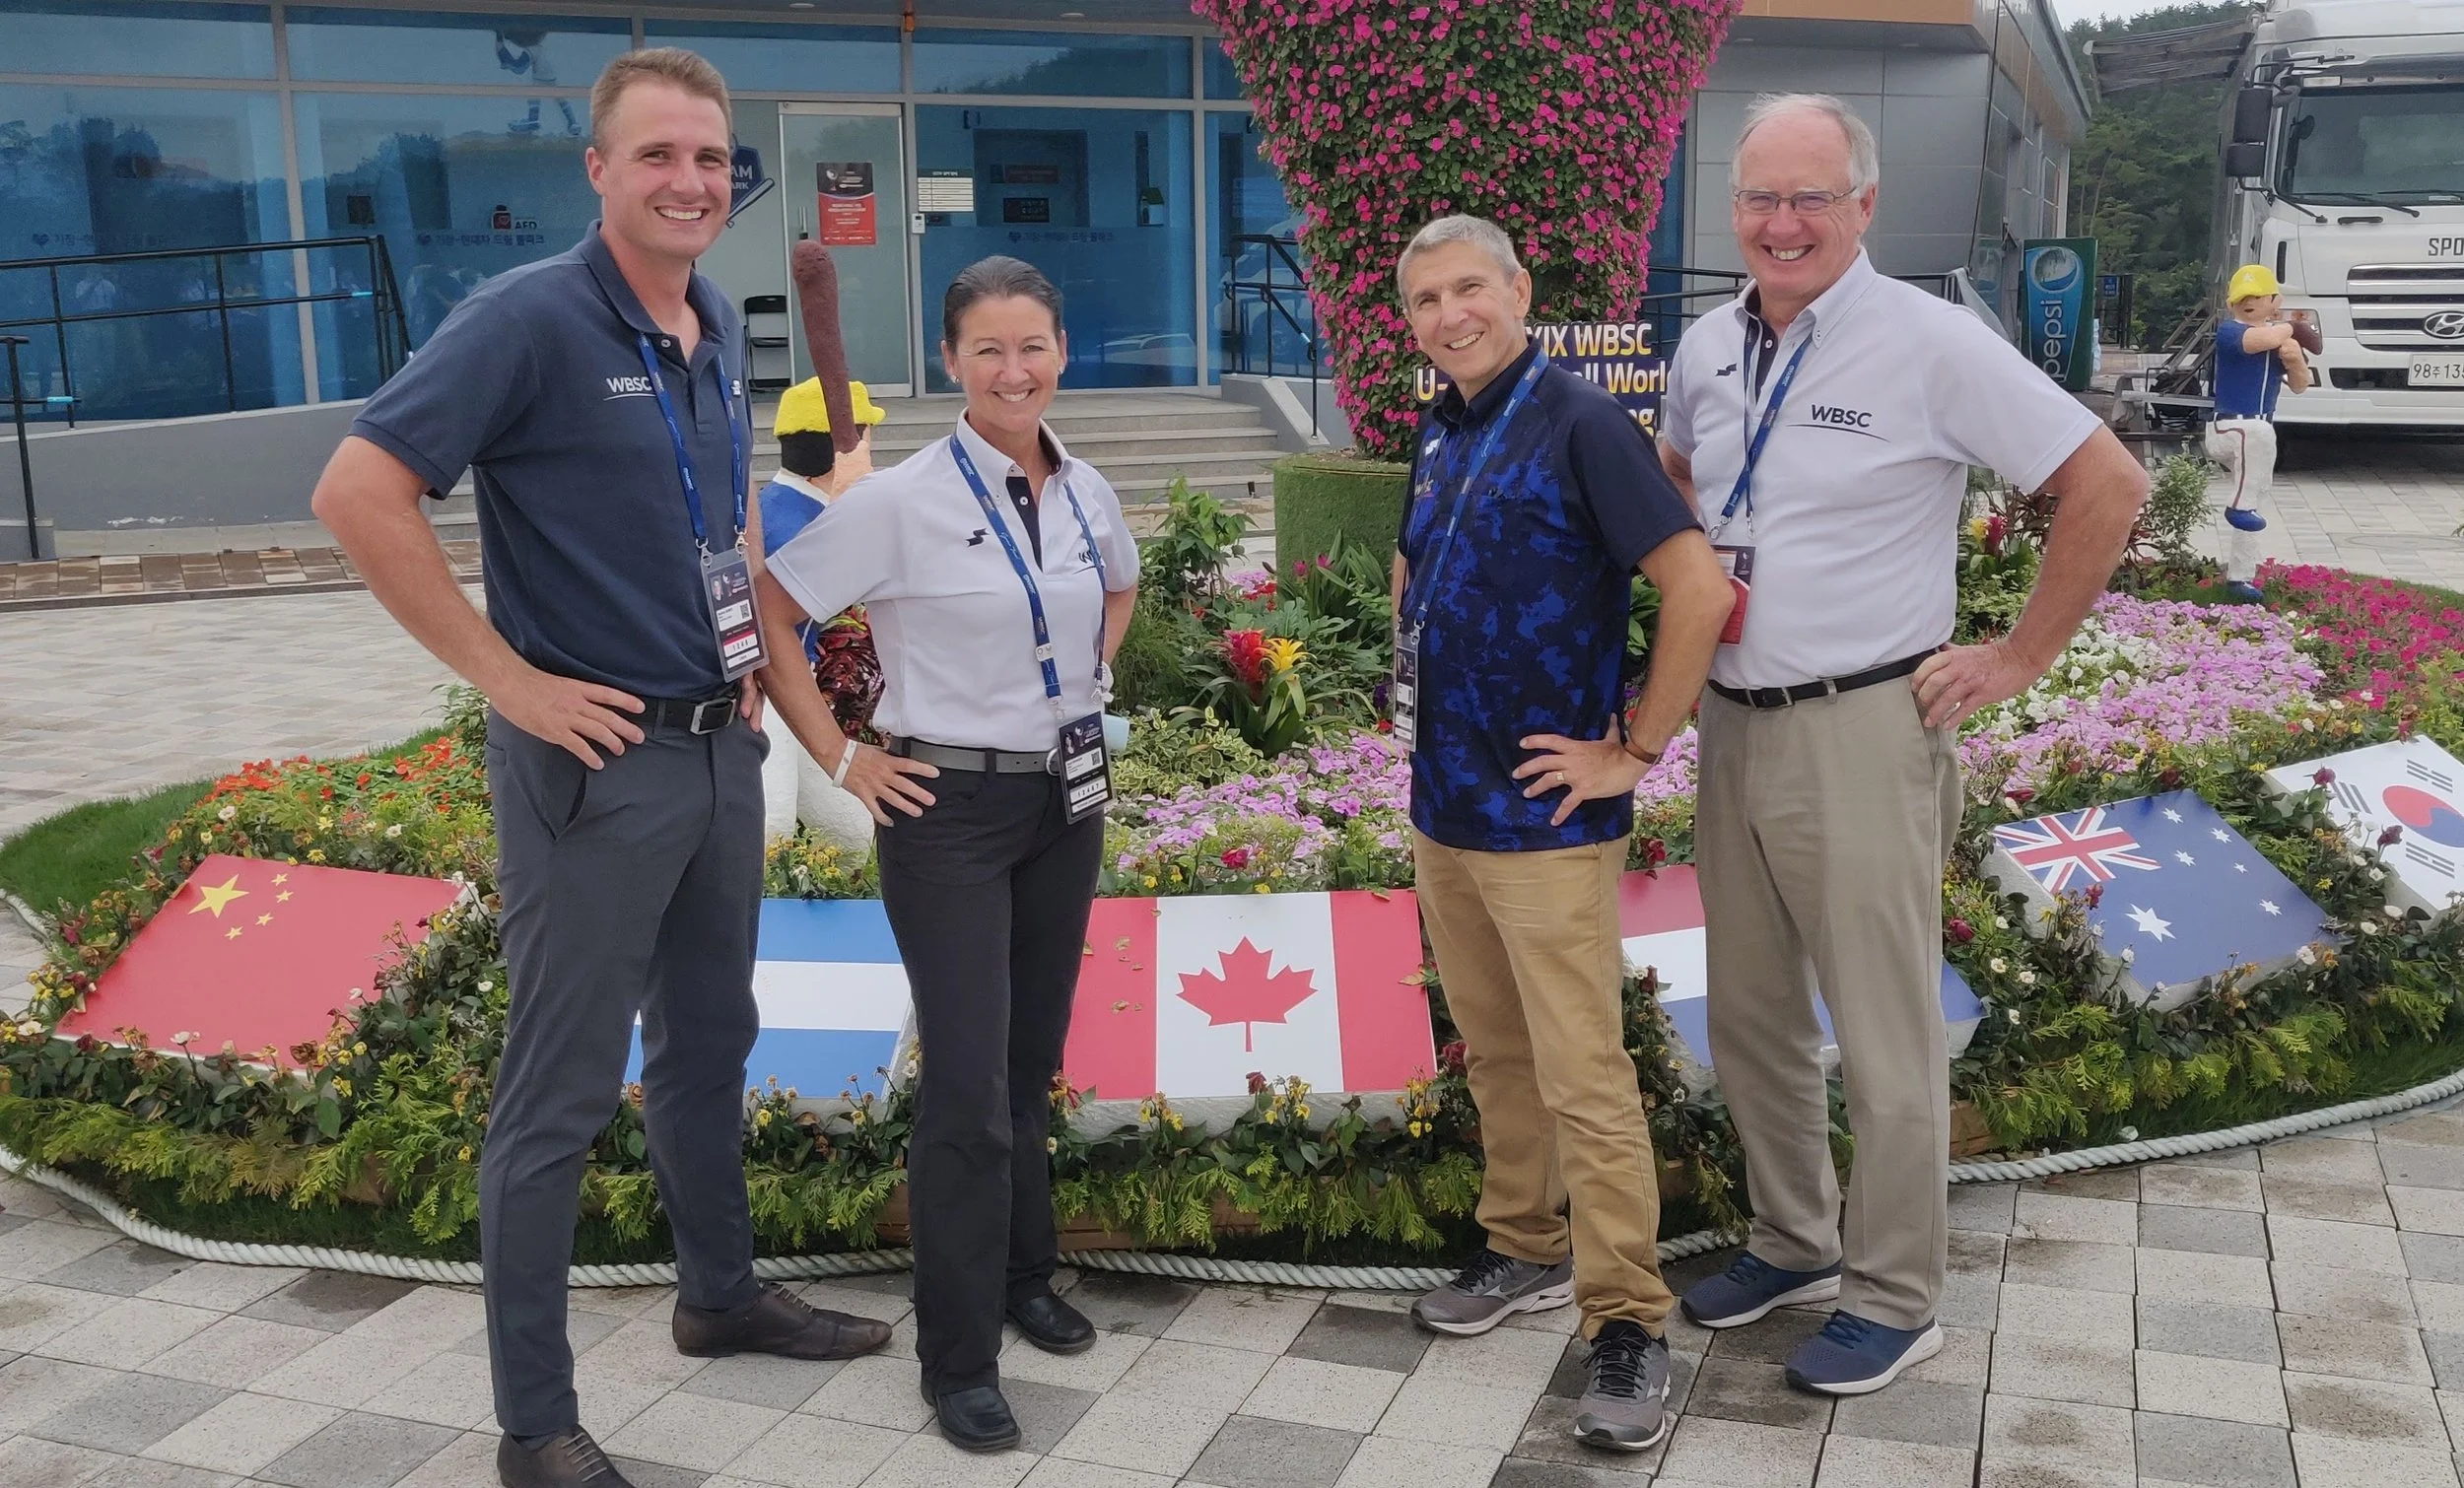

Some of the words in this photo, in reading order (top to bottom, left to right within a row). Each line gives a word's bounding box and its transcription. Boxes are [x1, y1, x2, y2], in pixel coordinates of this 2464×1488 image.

[1574, 322, 1653, 357] WBSC
[2040, 300, 2066, 378] pepsi
[606, 375, 652, 393] WBSC
[1606, 360, 1666, 394] Worl
[1812, 404, 1874, 428] WBSC
